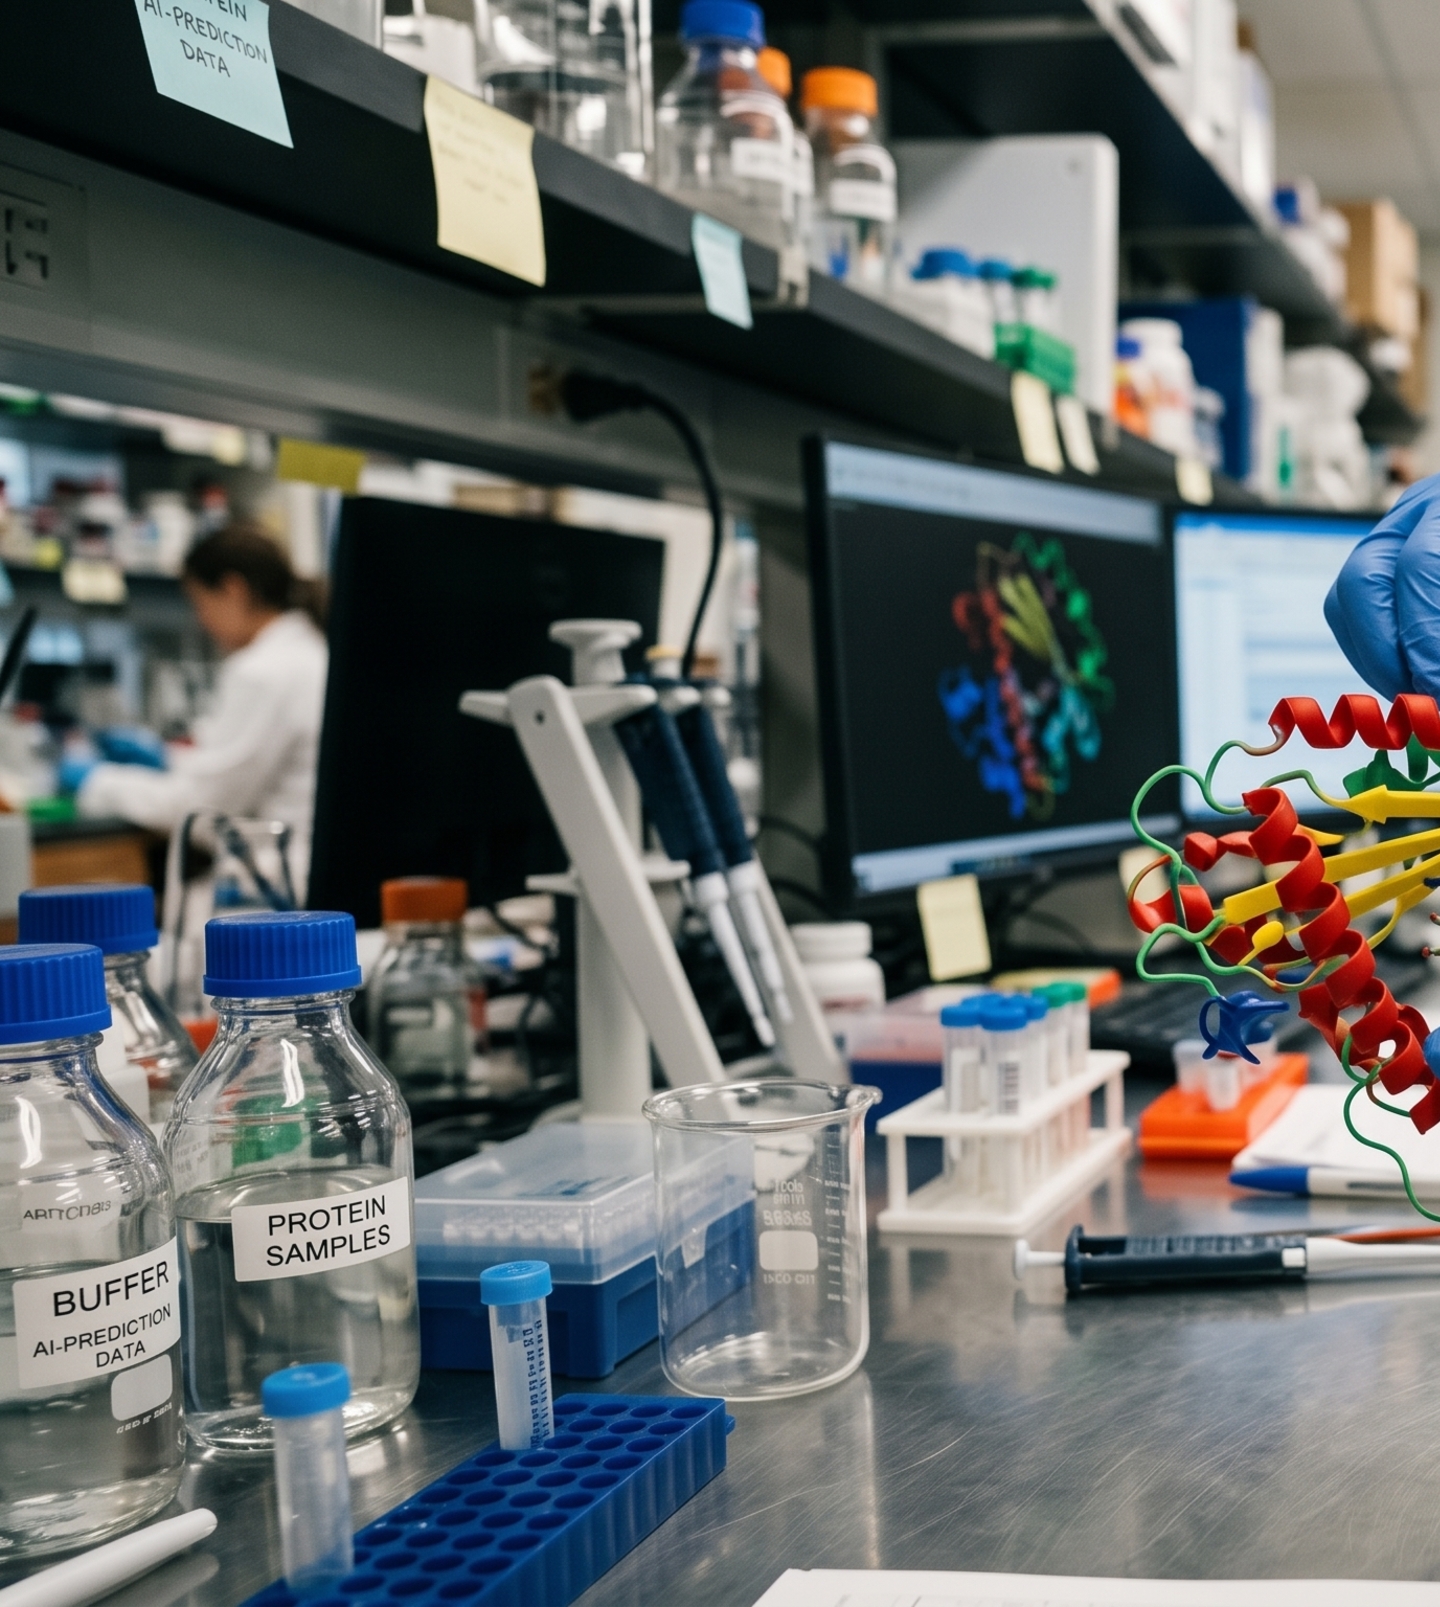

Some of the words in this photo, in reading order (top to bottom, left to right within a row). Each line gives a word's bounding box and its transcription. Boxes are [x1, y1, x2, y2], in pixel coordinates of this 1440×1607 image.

[144, 0, 267, 63] AI-PREDICTION
[180, 39, 230, 77] DATA
[268, 1195, 385, 1236] PROTEIN
[266, 1224, 390, 1266] SAMPLES
[53, 1261, 169, 1317] BUFFER
[33, 1303, 171, 1358] AI-PREDICTION
[96, 1340, 146, 1368] DATA
